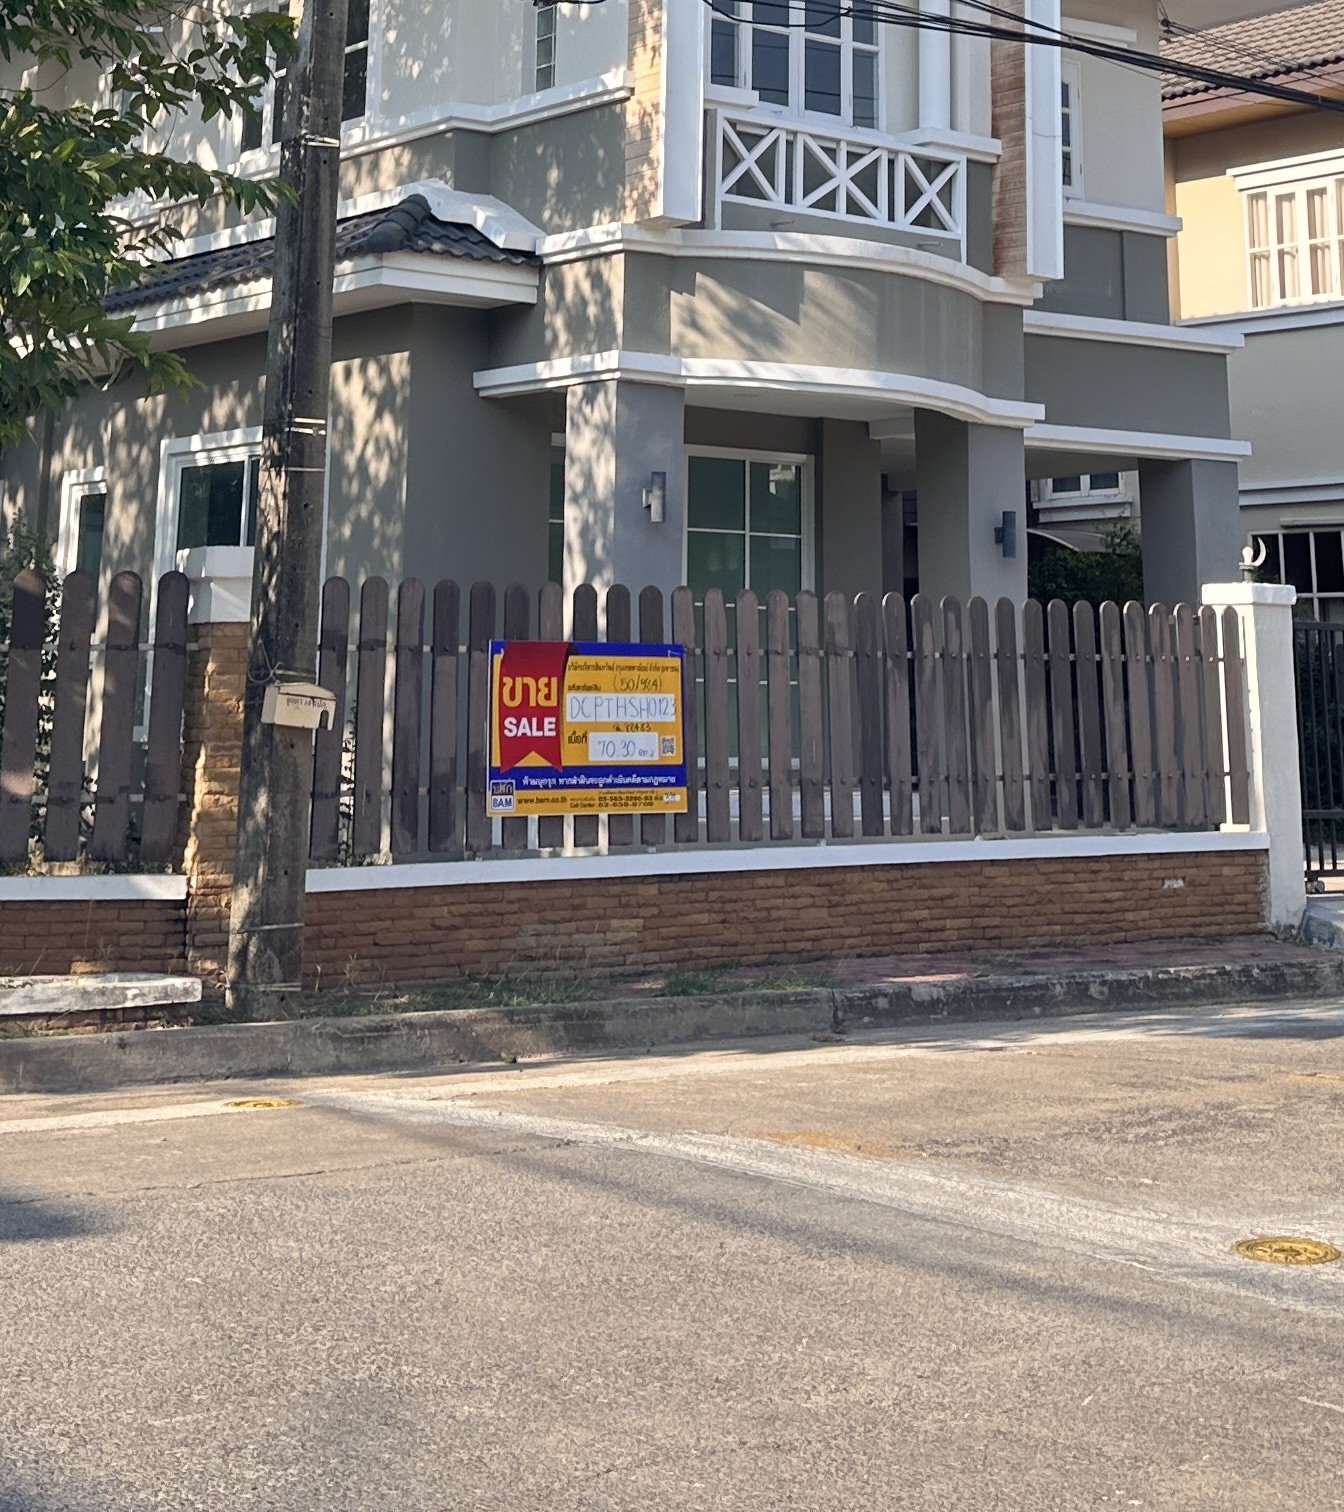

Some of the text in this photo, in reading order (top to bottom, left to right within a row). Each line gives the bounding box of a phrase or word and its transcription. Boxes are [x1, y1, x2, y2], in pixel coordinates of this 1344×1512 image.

[502, 676, 558, 707] ขาย
[503, 717, 556, 737] SALE
[492, 797, 512, 808] BAM
